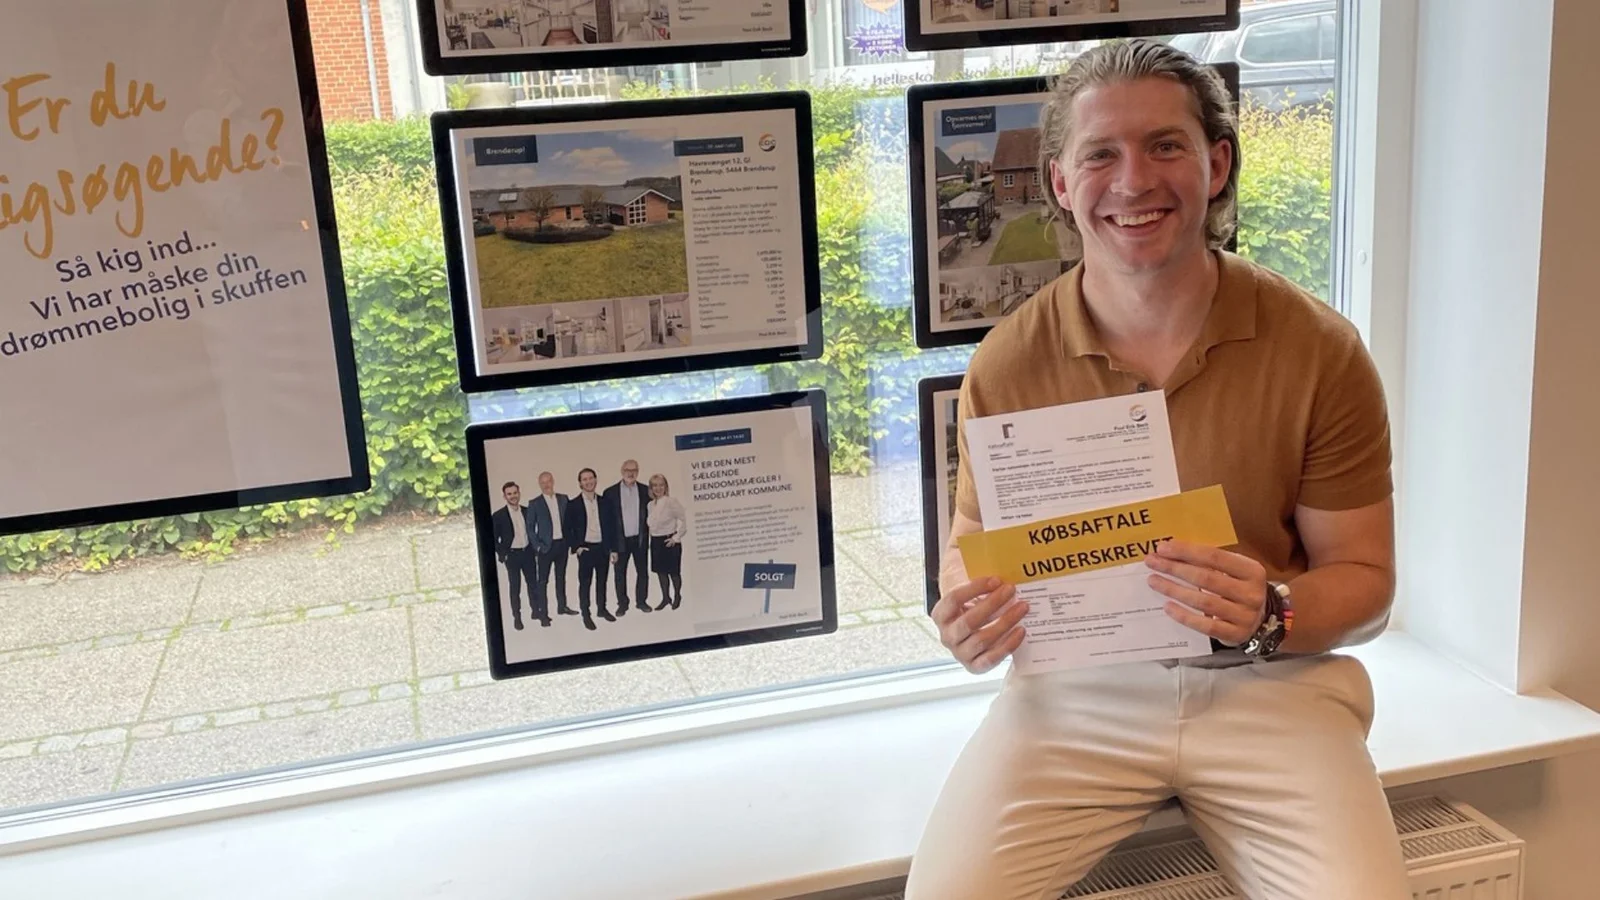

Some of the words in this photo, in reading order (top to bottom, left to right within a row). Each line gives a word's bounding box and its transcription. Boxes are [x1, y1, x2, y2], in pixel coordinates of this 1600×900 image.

[2, 73, 71, 141] Er
[90, 62, 166, 127] du
[485, 145, 526, 155] Brenderup!
[0, 108, 284, 260] igsøgende?
[56, 255, 92, 283] Så
[96, 248, 143, 273] kig
[147, 230, 217, 261] ind...
[30, 296, 62, 320] Vi
[66, 288, 112, 313] har
[121, 265, 208, 301] måske
[216, 253, 259, 277] din
[0, 297, 191, 356] drømmebolig
[194, 288, 205, 309] i
[211, 267, 307, 305] skuffen
[691, 462, 700, 470] VI
[701, 460, 713, 469] ER
[713, 459, 732, 467] DEN
[733, 456, 756, 465] MEST
[692, 468, 739, 481] SÆLGENDE
[693, 474, 777, 492] EJENDOMSMÆGLER
[693, 489, 746, 502] MIDDELFART
[748, 483, 792, 496] KOMMUNE
[1028, 508, 1152, 546] KØBSAFTALE
[754, 572, 785, 581] SOLGT
